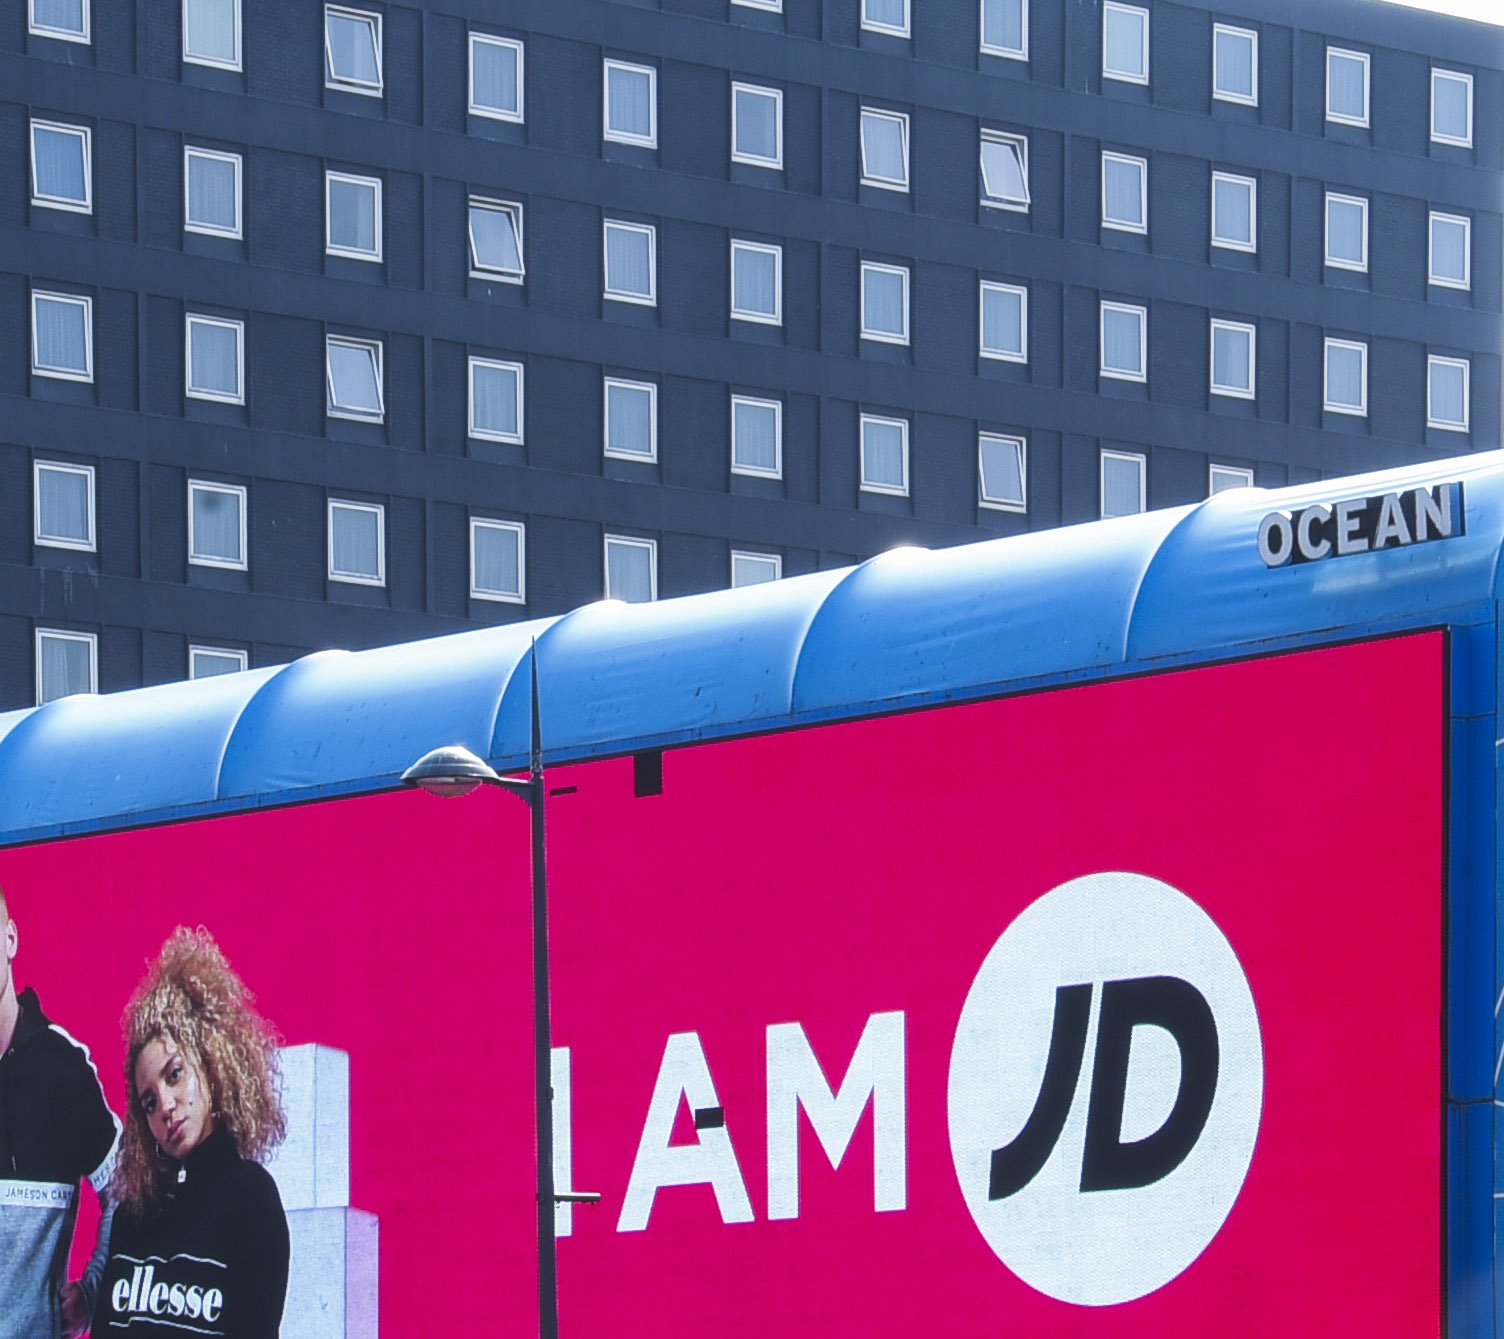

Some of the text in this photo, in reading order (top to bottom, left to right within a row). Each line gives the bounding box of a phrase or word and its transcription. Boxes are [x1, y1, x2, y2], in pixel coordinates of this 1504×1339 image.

[1256, 483, 1458, 570] OCEAN
[616, 1009, 907, 1233] AM
[988, 974, 1221, 1203] JD
[4, 1187, 48, 1200] JAMESON
[110, 1263, 224, 1326] ellesse
